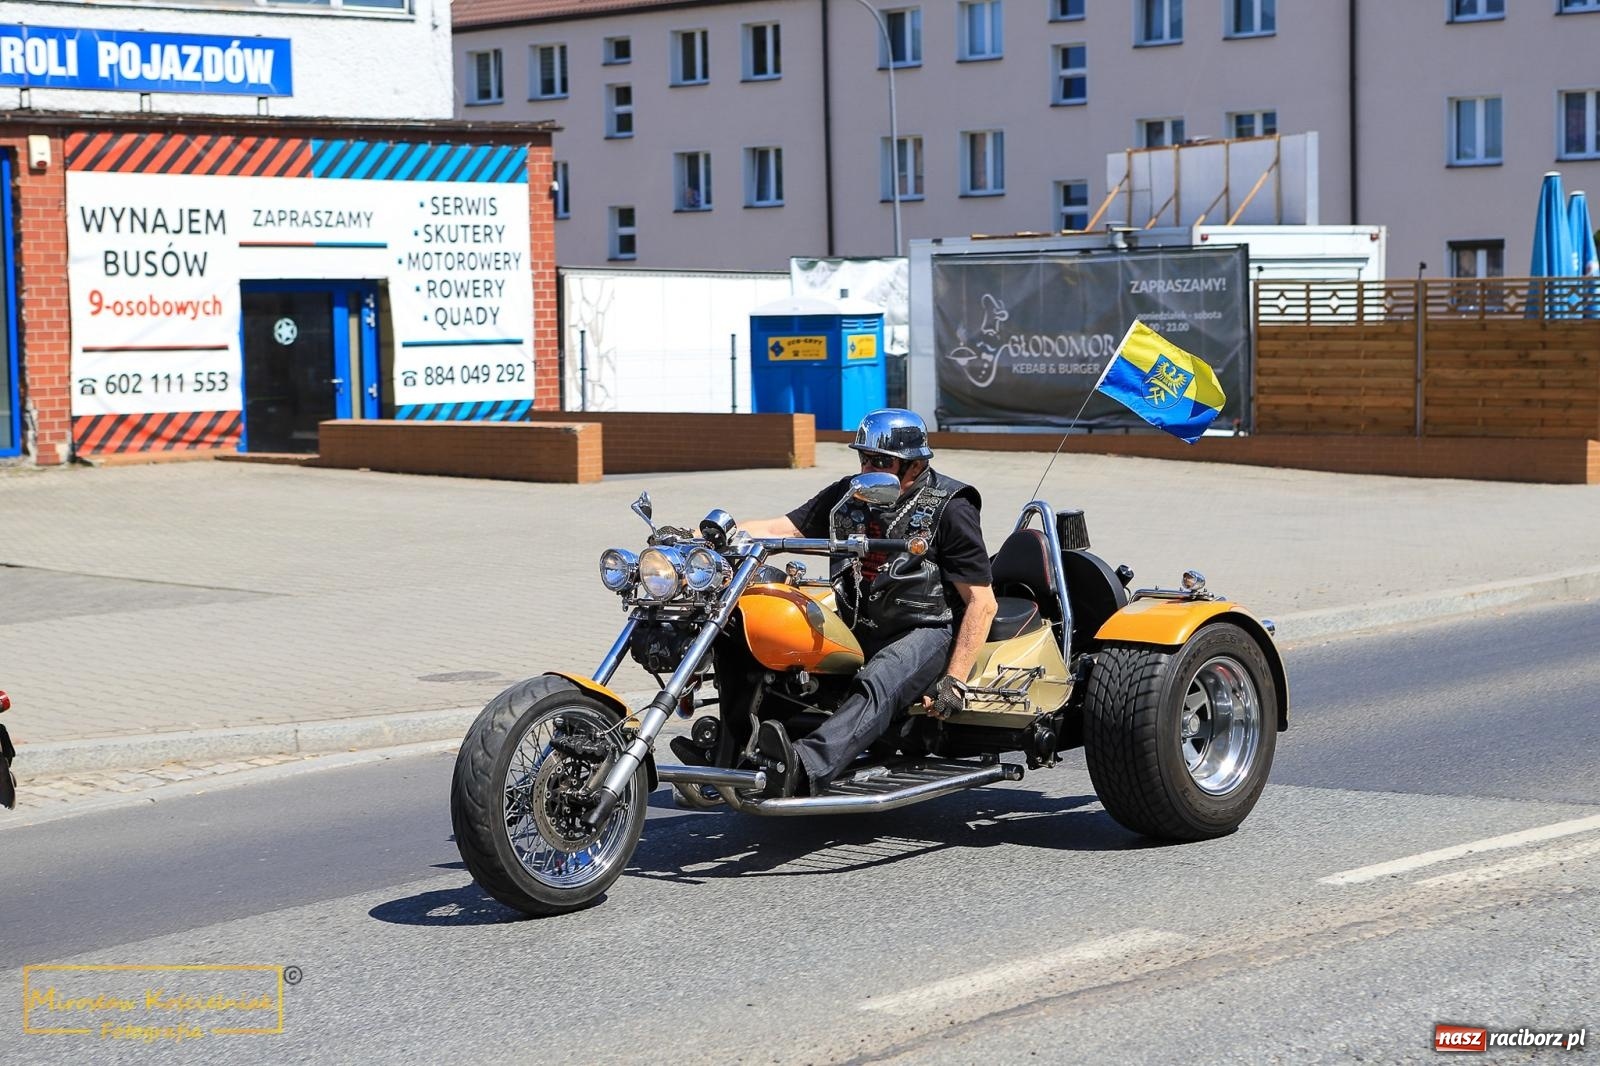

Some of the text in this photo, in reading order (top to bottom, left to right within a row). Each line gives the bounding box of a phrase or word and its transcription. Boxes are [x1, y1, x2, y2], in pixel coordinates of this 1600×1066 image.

[0, 36, 275, 85] ROLI POJAZDÓW
[431, 196, 498, 216] SERWIS
[80, 206, 226, 235] WYNAJEM
[252, 209, 374, 228] ZAPRASZAMY
[423, 224, 505, 243] SKUTERY
[104, 242, 207, 277] BUSÓW
[407, 252, 521, 271] MOTOROWERY
[427, 279, 505, 299] ROWERY
[1130, 278, 1227, 294] ZAPRASZAMY!
[89, 289, 223, 321] 9-osobowych
[1194, 311, 1222, 320] sobota
[435, 306, 500, 331] QUADY
[1008, 334, 1116, 358] GŁODOMOR
[424, 363, 526, 386] 884 049 292
[1012, 363, 1100, 375] KEBAB & BURGER
[105, 371, 229, 395] 602 111 553
